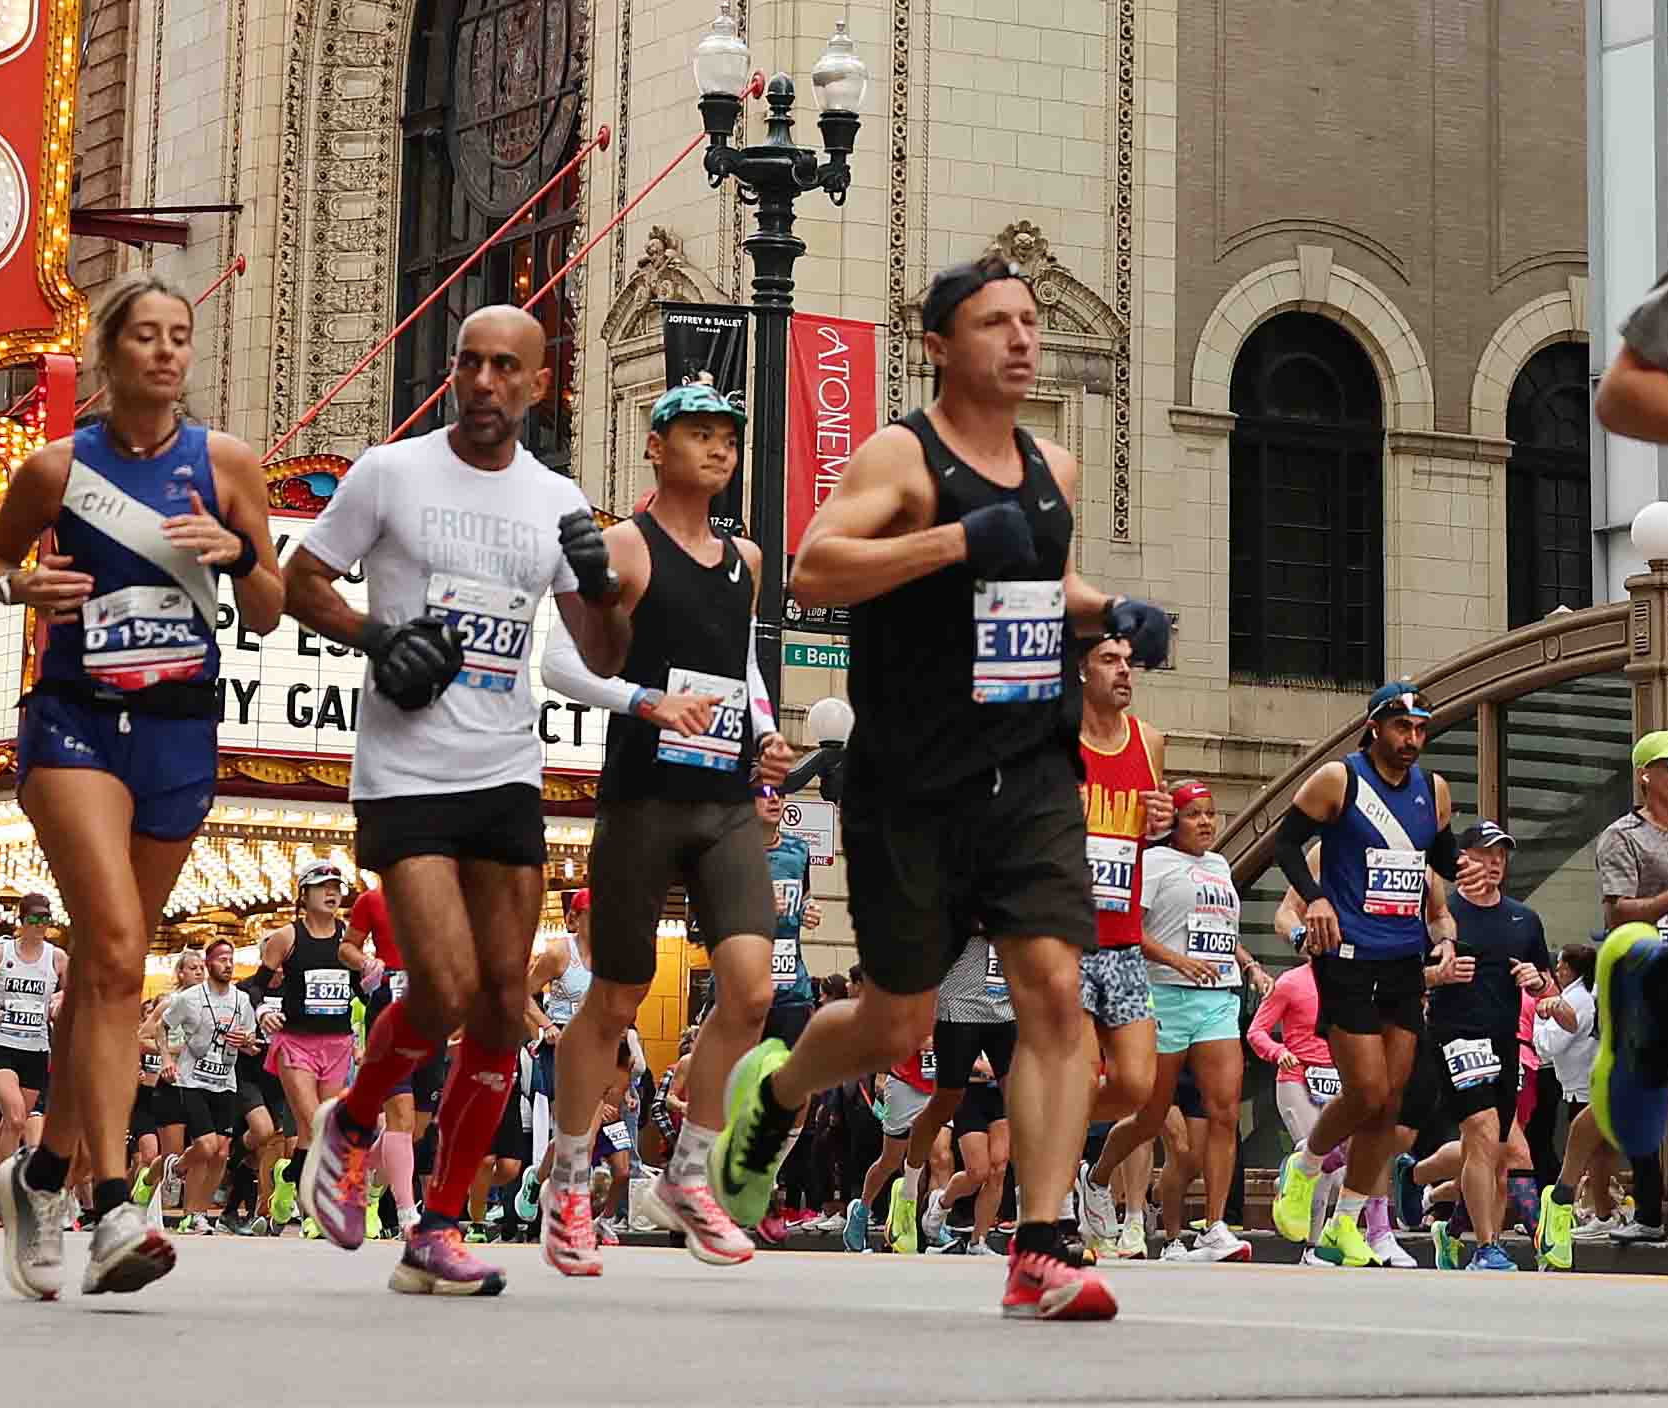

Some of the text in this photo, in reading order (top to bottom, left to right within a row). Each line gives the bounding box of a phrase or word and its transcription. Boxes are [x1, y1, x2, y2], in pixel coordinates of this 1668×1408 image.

[668, 314, 743, 332] JOFFREY BALLET
[814, 326, 851, 512] ATONEM
[79, 502, 128, 517] CHI
[421, 506, 539, 559] PROTECT
[86, 630, 109, 649] D
[977, 622, 998, 657] E
[794, 650, 802, 661] E
[530, 700, 606, 748] CT
[708, 708, 744, 740] 795
[1366, 801, 1390, 825] CHI
[810, 856, 829, 865] ONE
[1368, 869, 1425, 892] F 25027
[1189, 932, 1237, 953] E 10651
[773, 954, 797, 974] 909
[988, 959, 999, 975] E
[5, 978, 45, 993] FREAKS
[306, 983, 352, 999] E 8278
[145, 1054, 152, 1064] E
[196, 1058, 203, 1069] E
[1447, 1058, 1460, 1075] E
[1308, 1078, 1316, 1089] E
